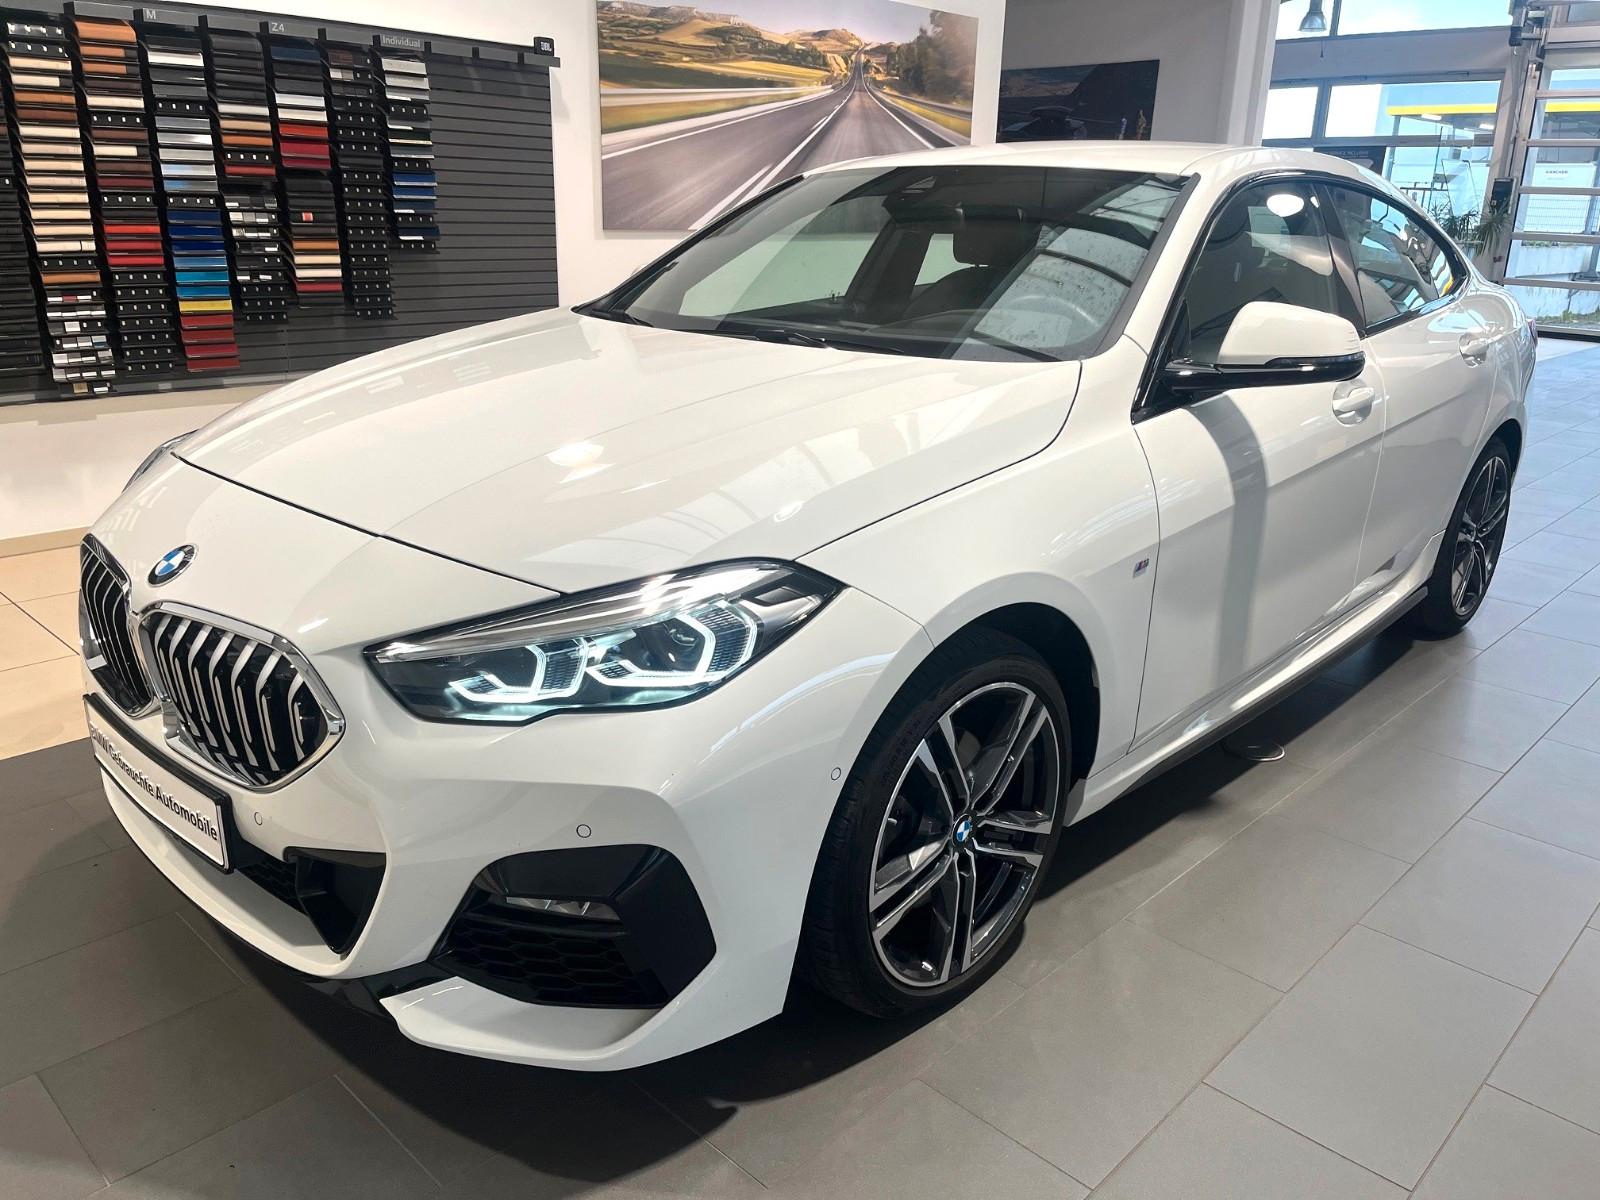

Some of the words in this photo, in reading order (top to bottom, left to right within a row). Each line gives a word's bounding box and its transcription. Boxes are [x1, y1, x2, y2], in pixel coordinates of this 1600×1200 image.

[146, 10, 157, 20] M
[271, 22, 285, 32] Z4
[382, 34, 421, 48] Individual
[108, 744, 155, 797] Gebrauchte
[156, 786, 218, 841] Automobile
